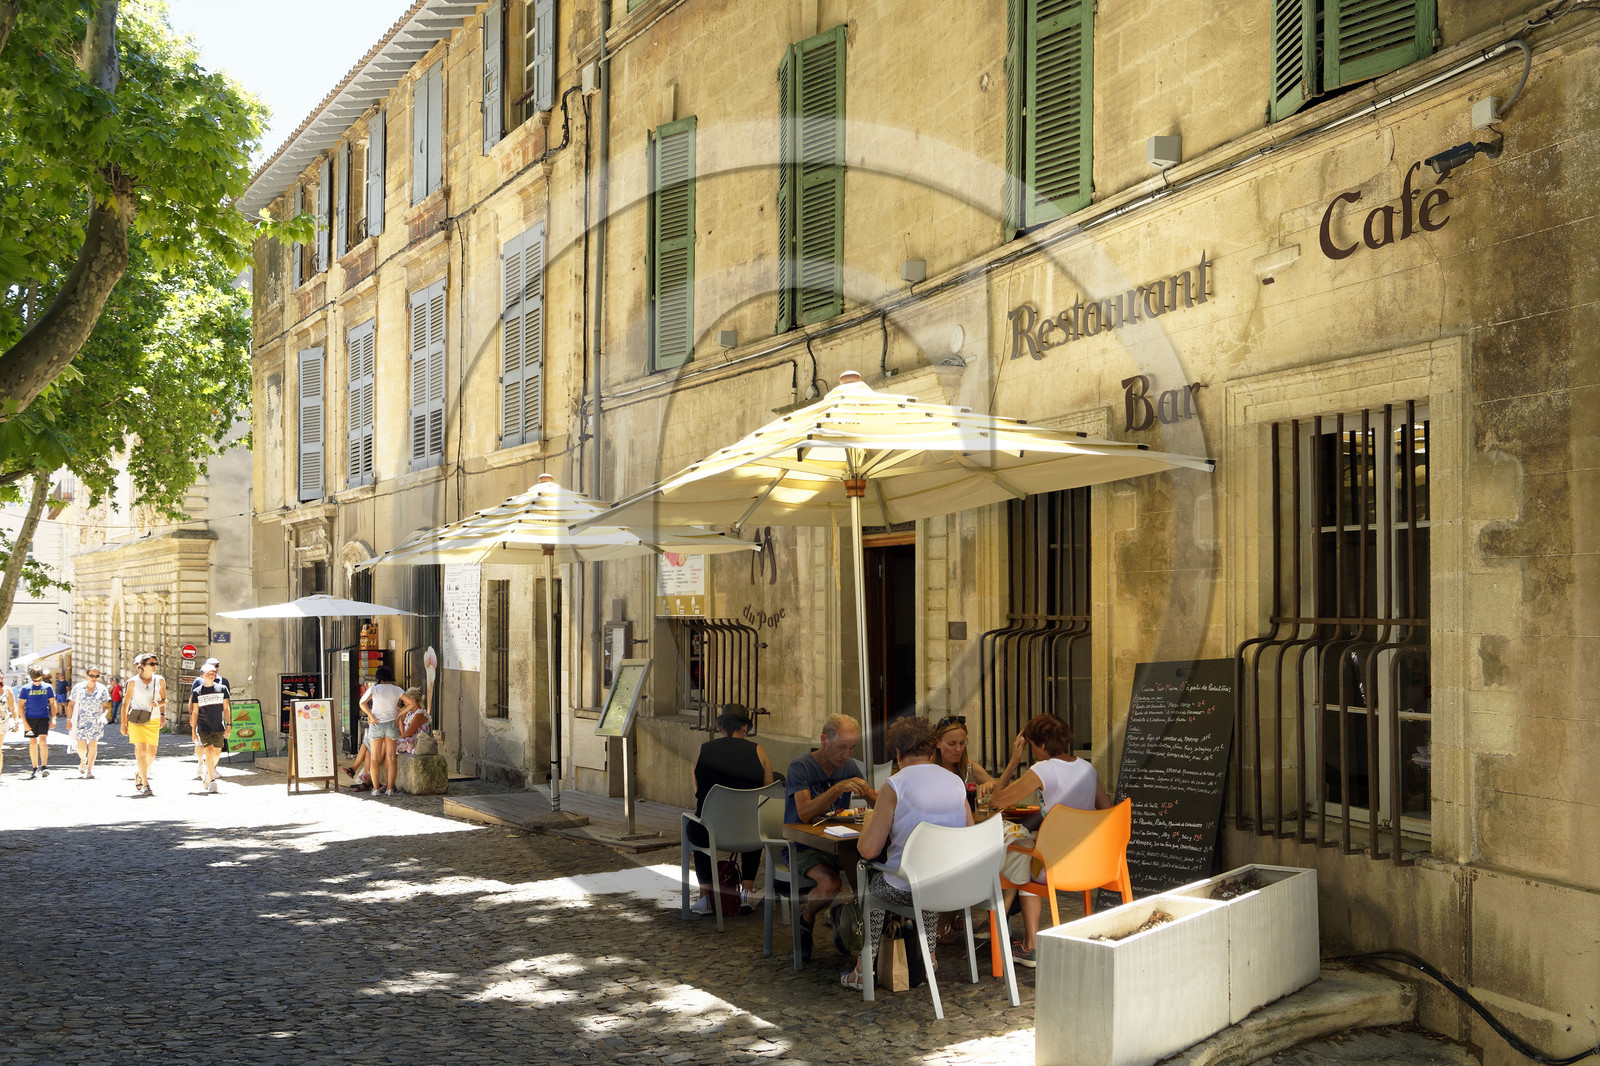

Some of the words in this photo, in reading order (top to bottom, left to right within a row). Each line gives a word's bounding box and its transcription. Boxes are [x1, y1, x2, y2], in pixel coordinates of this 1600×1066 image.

[1319, 160, 1452, 260] Café
[1008, 249, 1213, 361] Restaurant
[1121, 374, 1205, 433] Bar
[743, 604, 755, 625] du
[757, 608, 786, 630] Pape
